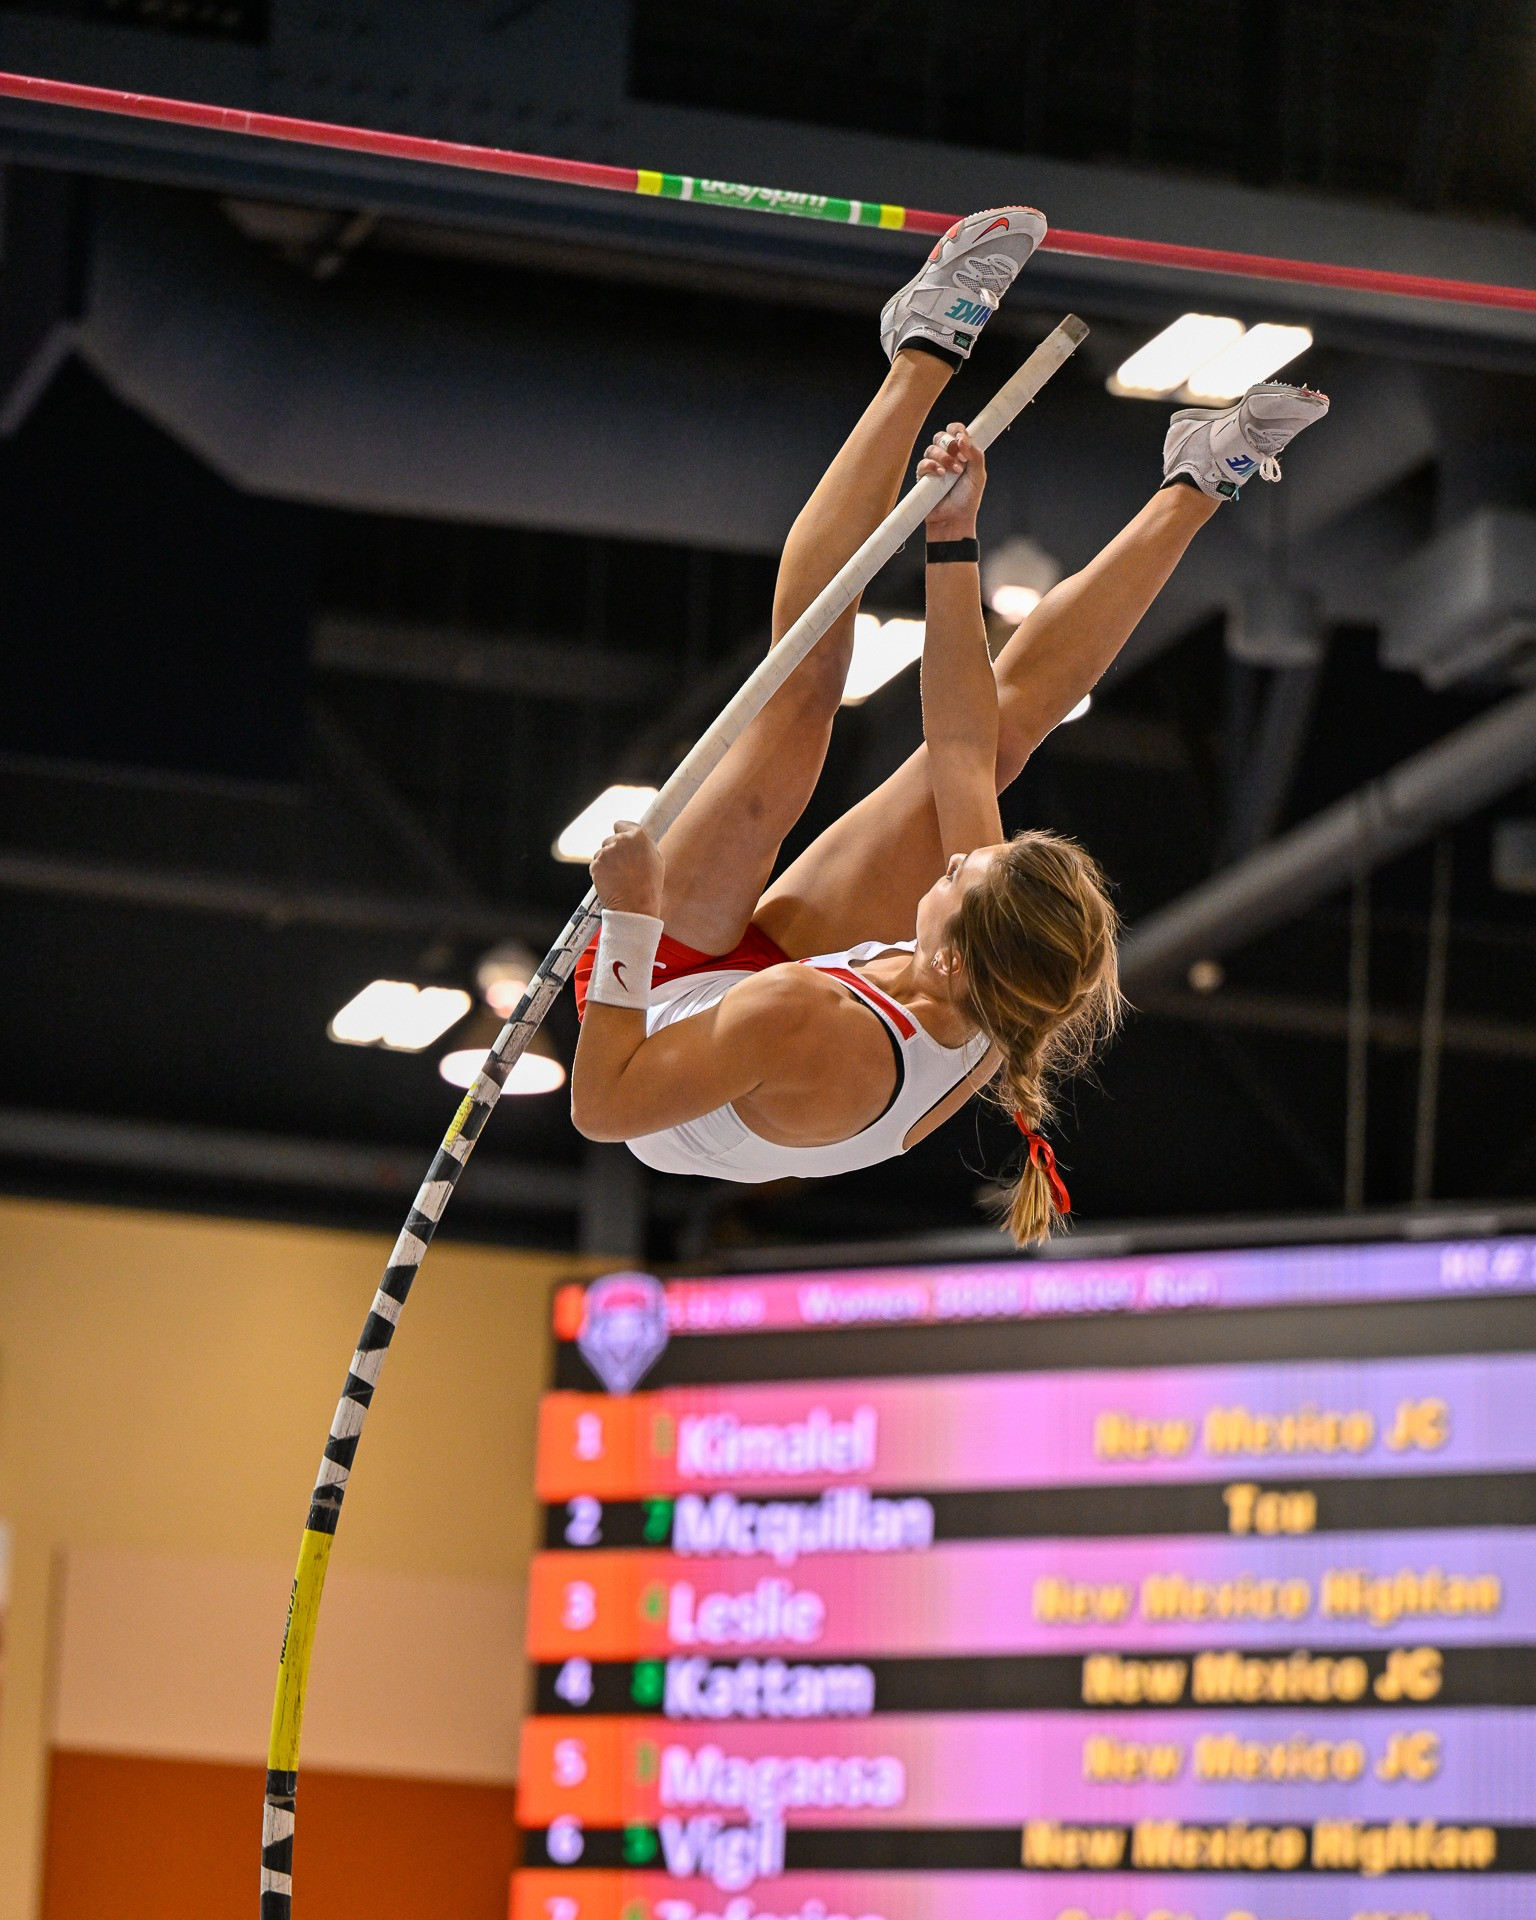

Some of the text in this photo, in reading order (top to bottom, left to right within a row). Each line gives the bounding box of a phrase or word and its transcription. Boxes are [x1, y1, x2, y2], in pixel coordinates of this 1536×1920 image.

[574, 1411, 604, 1462] 1
[1095, 1398, 1449, 1459] New Mexico JC
[565, 1495, 604, 1547] 2
[671, 1485, 935, 1567] Mcquillan
[562, 1581, 596, 1632] 3
[666, 1577, 826, 1647] Leslie
[1033, 1575, 1130, 1626] New
[1140, 1571, 1311, 1623] Mexico
[554, 1657, 594, 1707] 4
[663, 1655, 876, 1720] Kattam
[1082, 1646, 1445, 1705] New Mexico JC
[552, 1737, 588, 1788] 5
[659, 1744, 905, 1818] Magassa
[1083, 1730, 1443, 1783] New Mexico JC
[545, 1813, 585, 1865] 6
[658, 1813, 786, 1892] Vigil
[1021, 1819, 1127, 1869] New
[1131, 1817, 1307, 1870] Mexico
